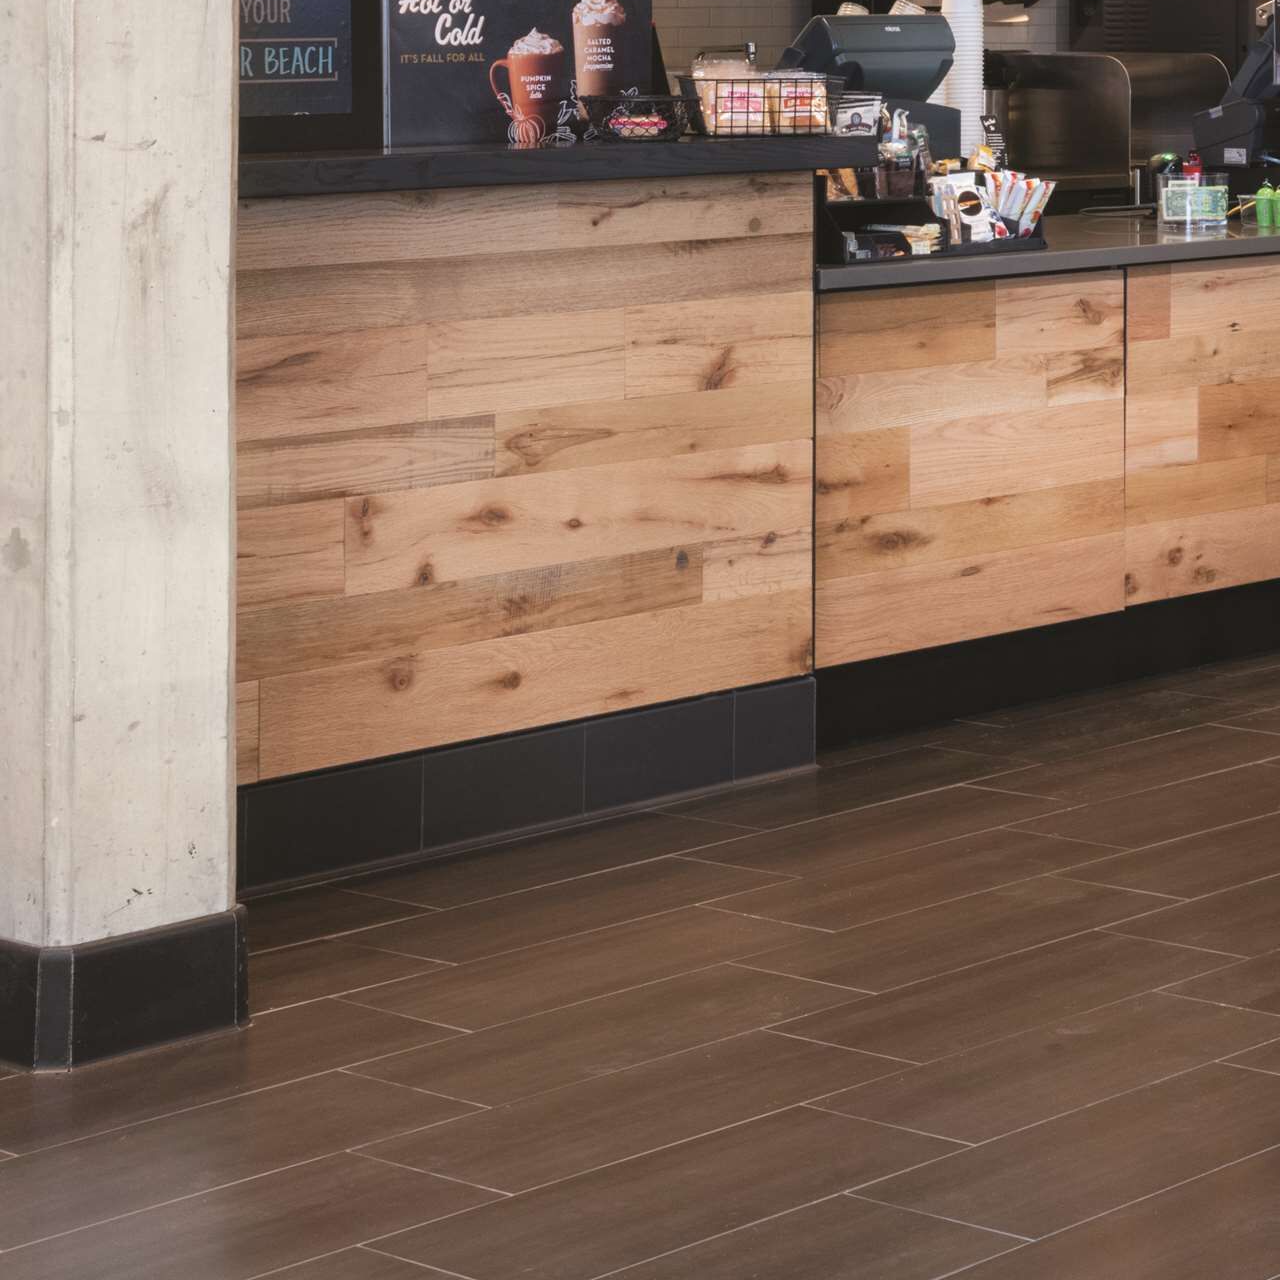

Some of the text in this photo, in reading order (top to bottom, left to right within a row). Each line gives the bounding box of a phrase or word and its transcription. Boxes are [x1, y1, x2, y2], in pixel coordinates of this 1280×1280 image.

[434, 13, 485, 46] Cold
[264, 46, 333, 75] BEACH
[400, 52, 485, 64] IT'S FALL FOR ALL
